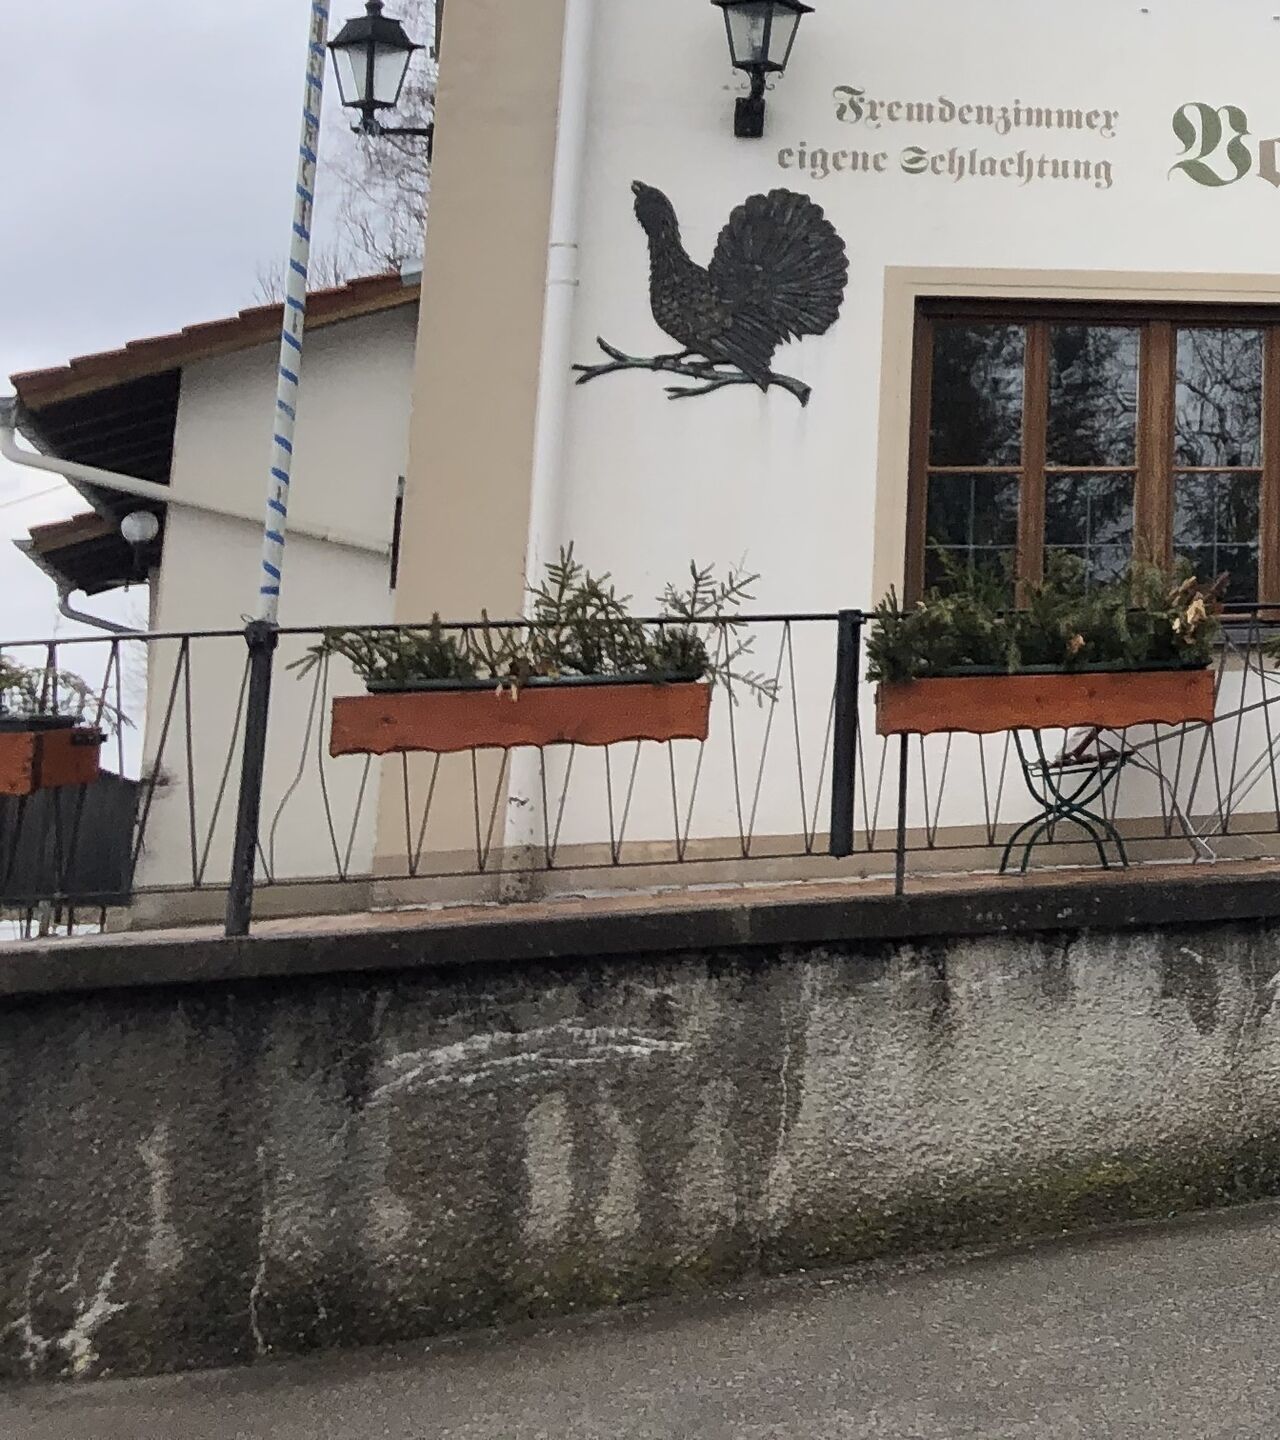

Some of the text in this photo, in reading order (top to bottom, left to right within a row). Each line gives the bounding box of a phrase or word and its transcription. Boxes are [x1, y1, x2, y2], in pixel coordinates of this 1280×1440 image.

[832, 84, 1119, 139] Fremdenzimmer
[777, 141, 1114, 189] eigene Schlachtung
